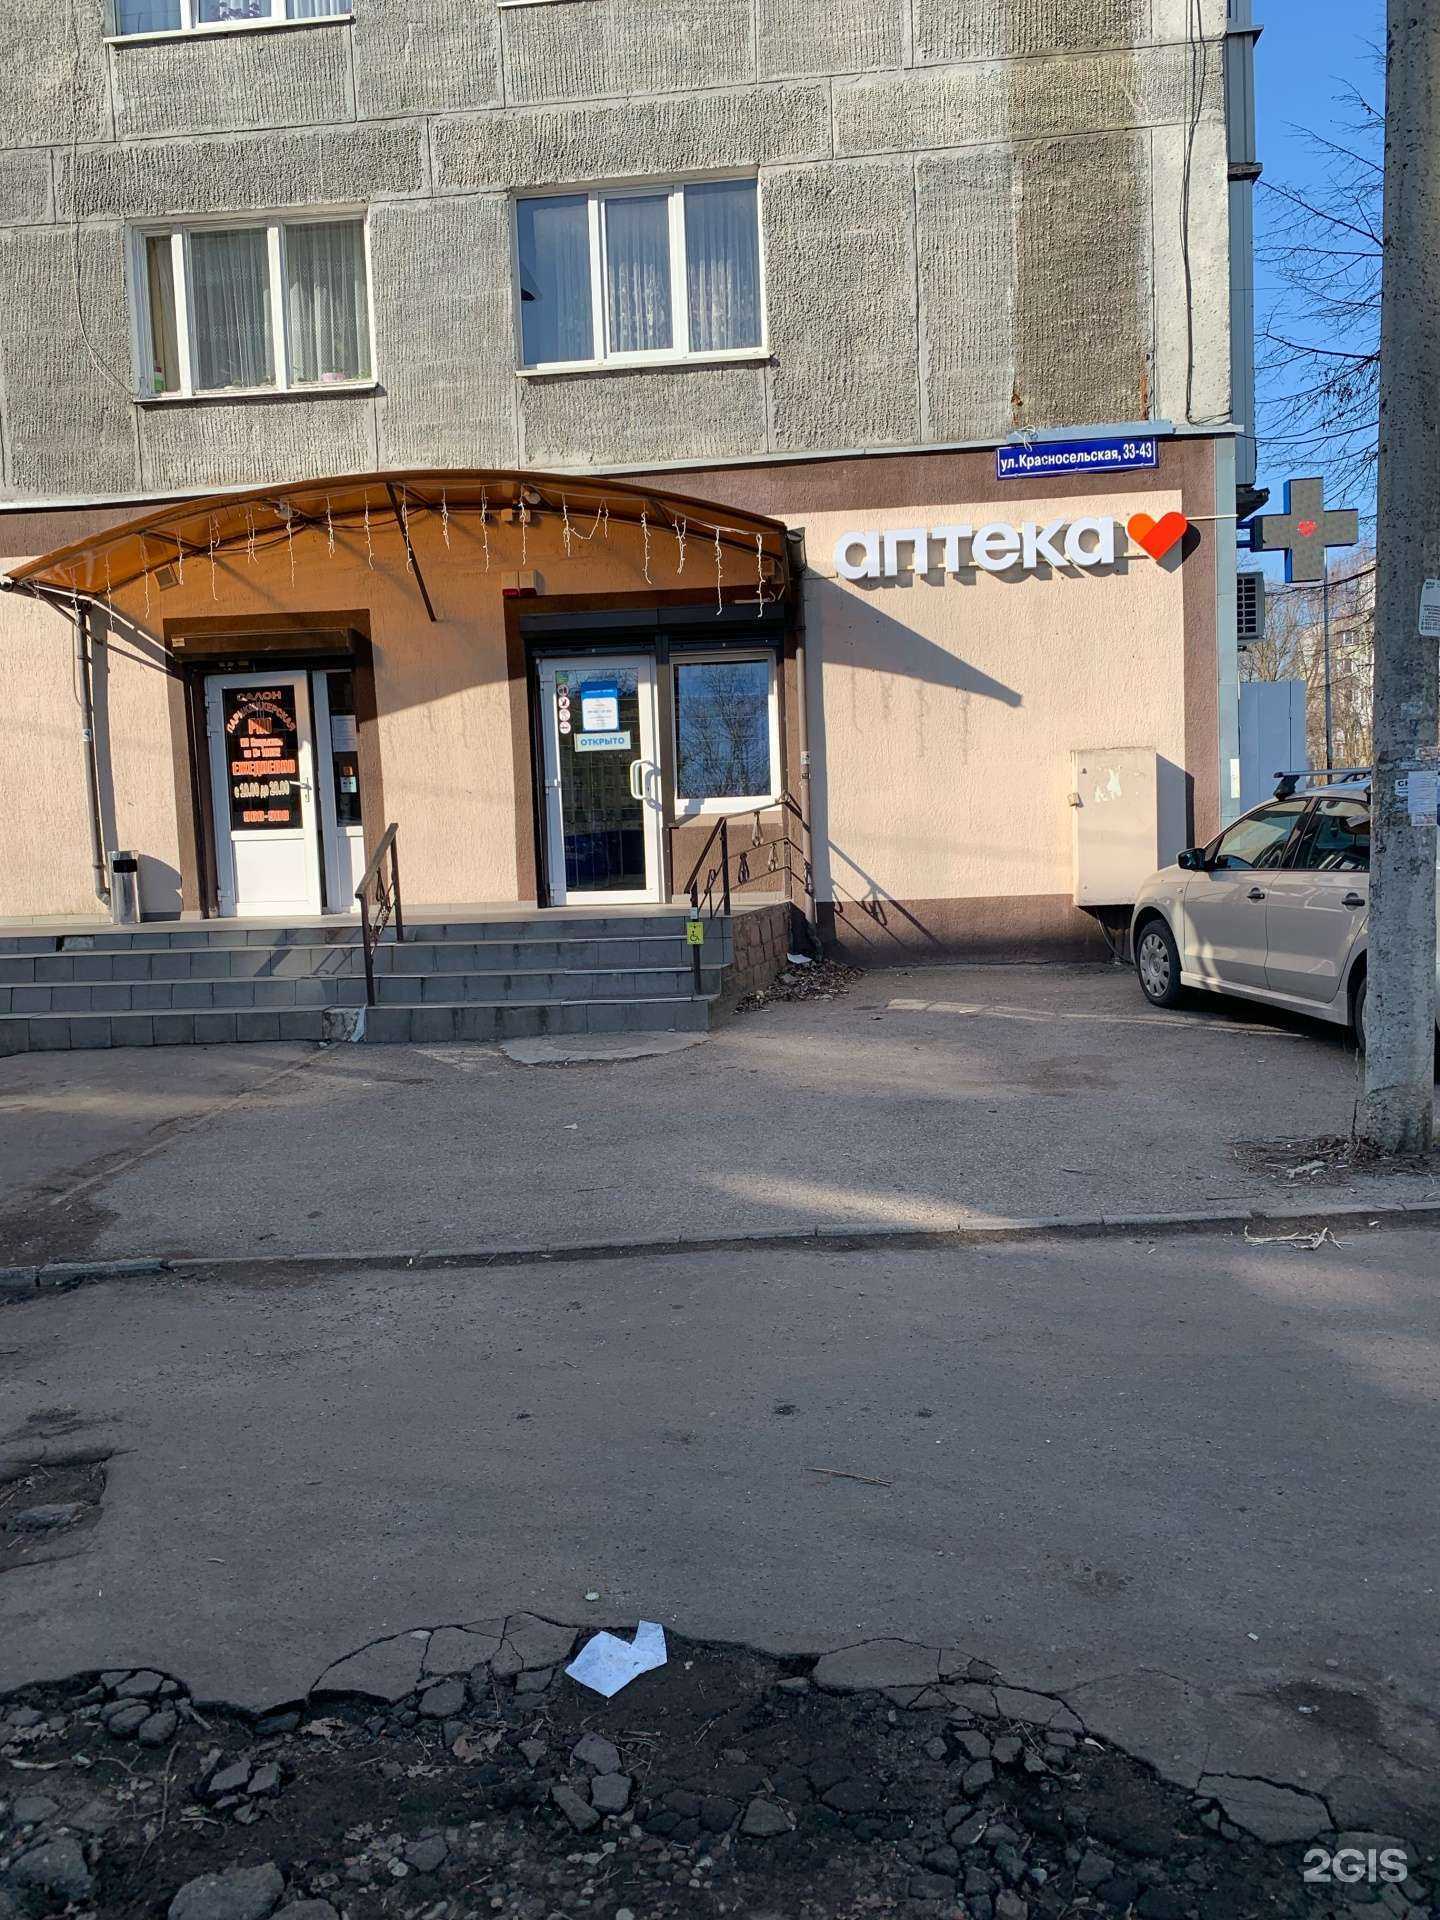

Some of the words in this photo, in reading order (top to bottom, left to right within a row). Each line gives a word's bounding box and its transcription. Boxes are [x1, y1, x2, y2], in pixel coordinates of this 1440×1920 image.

[1123, 442, 1152, 460] 33-43
[835, 516, 1114, 580] аптека
[581, 737, 625, 746] ОТКРЫТО
